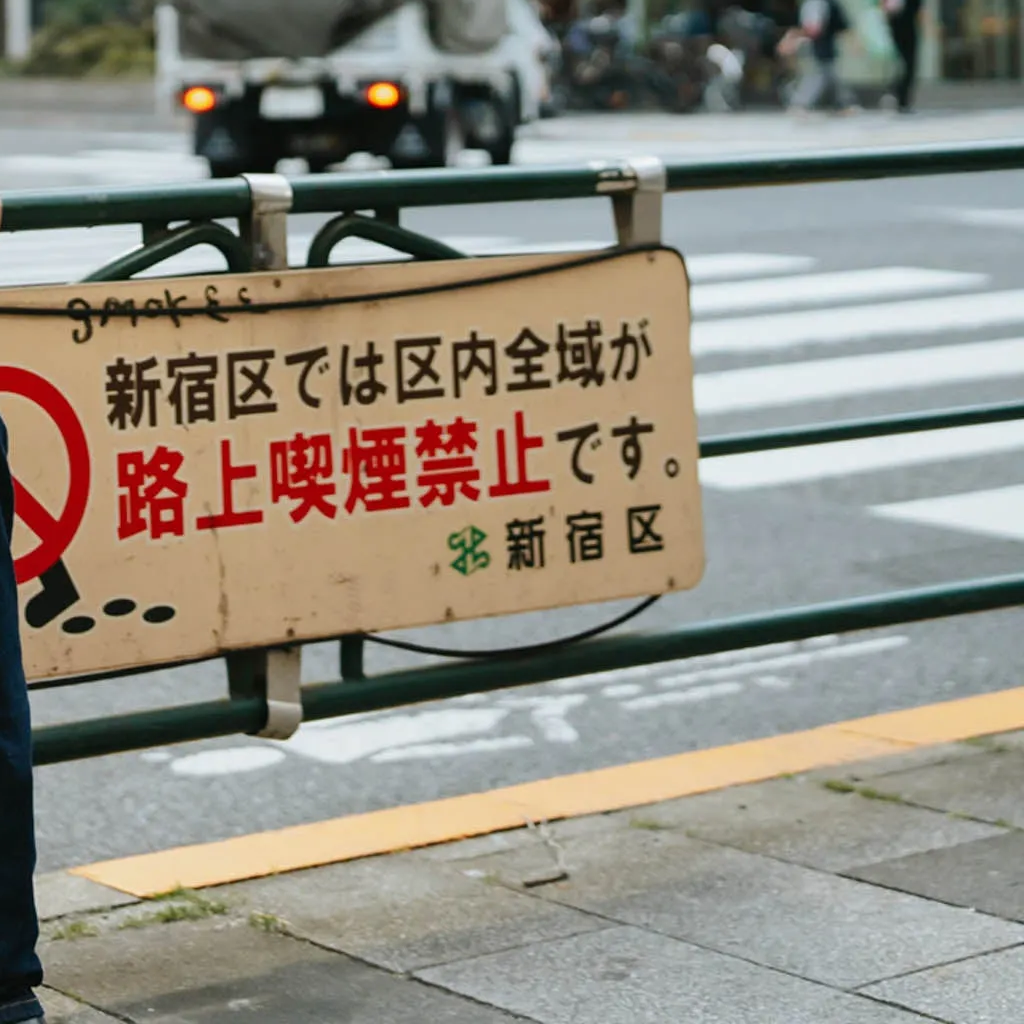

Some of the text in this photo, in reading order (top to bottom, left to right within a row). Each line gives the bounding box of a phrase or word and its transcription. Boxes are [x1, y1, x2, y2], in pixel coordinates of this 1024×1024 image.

[105, 317, 653, 431] 新宿区では区内全域が
[116, 410, 681, 542] 路上喫煙禁止です。
[506, 504, 664, 572] 新宿区
